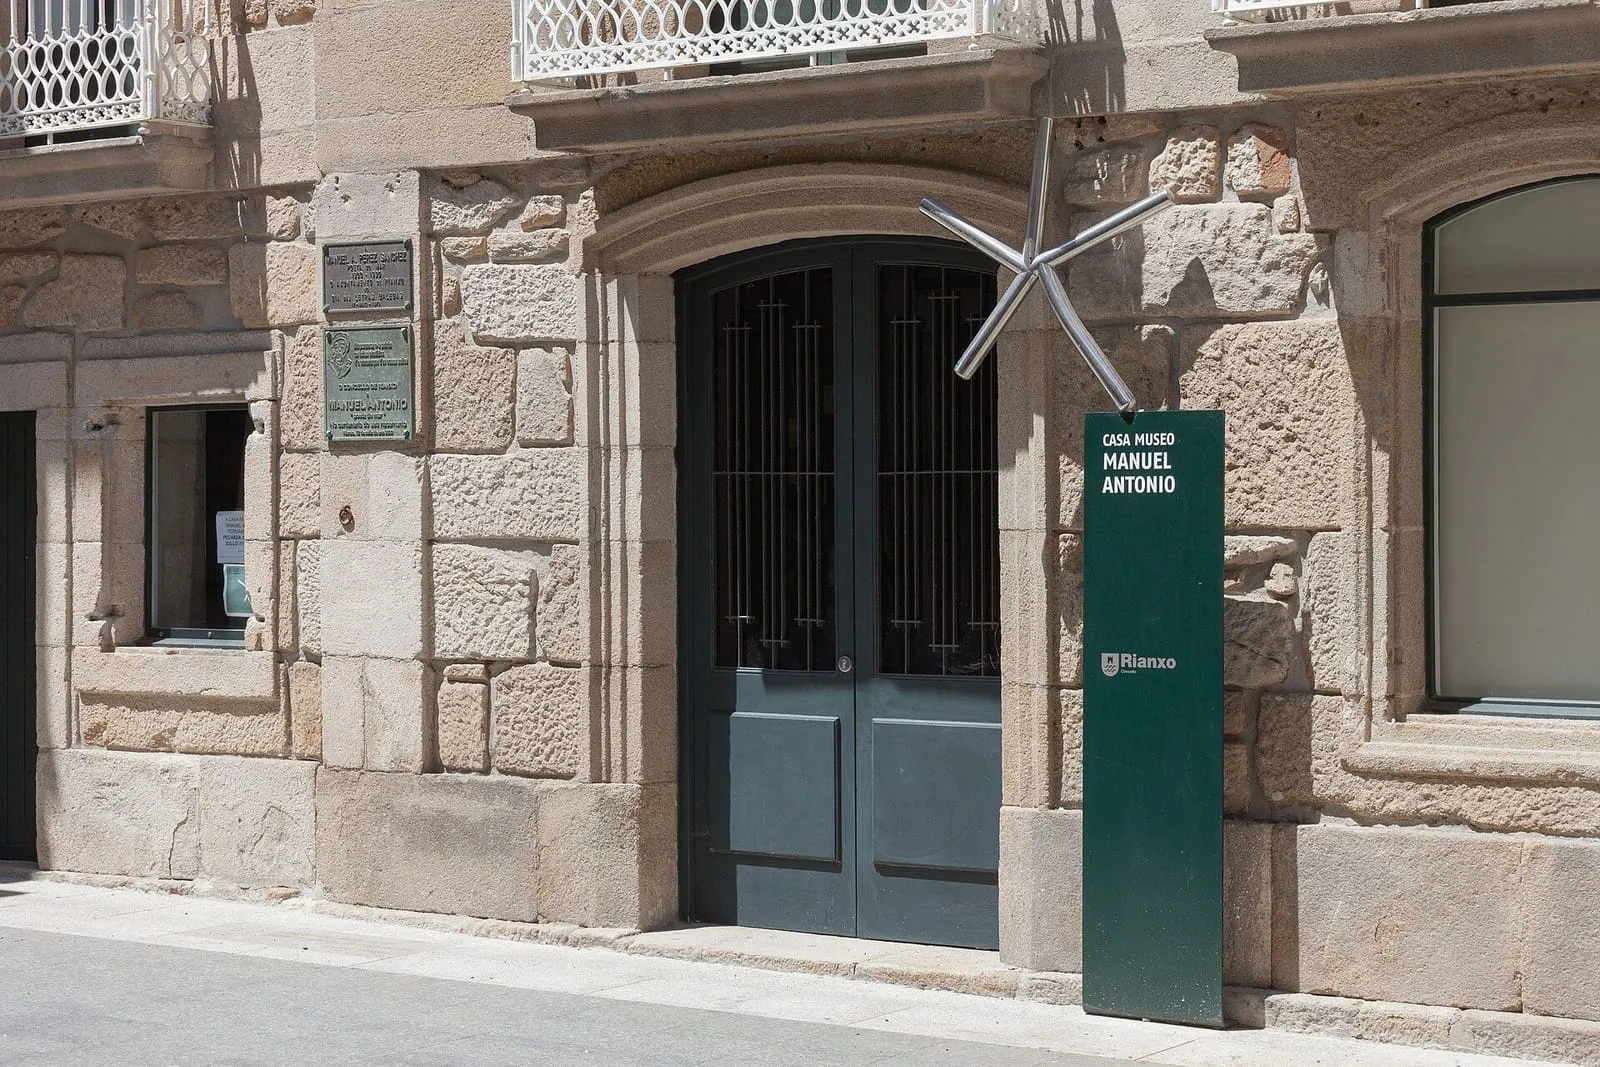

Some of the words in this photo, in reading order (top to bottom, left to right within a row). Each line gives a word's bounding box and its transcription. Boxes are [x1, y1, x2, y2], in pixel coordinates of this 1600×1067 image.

[359, 252, 378, 264] PEREZ
[328, 400, 366, 412] MANUEL
[367, 398, 408, 411] ANTONIO
[1102, 434, 1130, 446] CASA
[1135, 433, 1175, 446] MUSEO
[1103, 452, 1172, 470] MANUEL
[1102, 476, 1176, 493] ANTONIO
[1120, 654, 1176, 669] Rianxo
